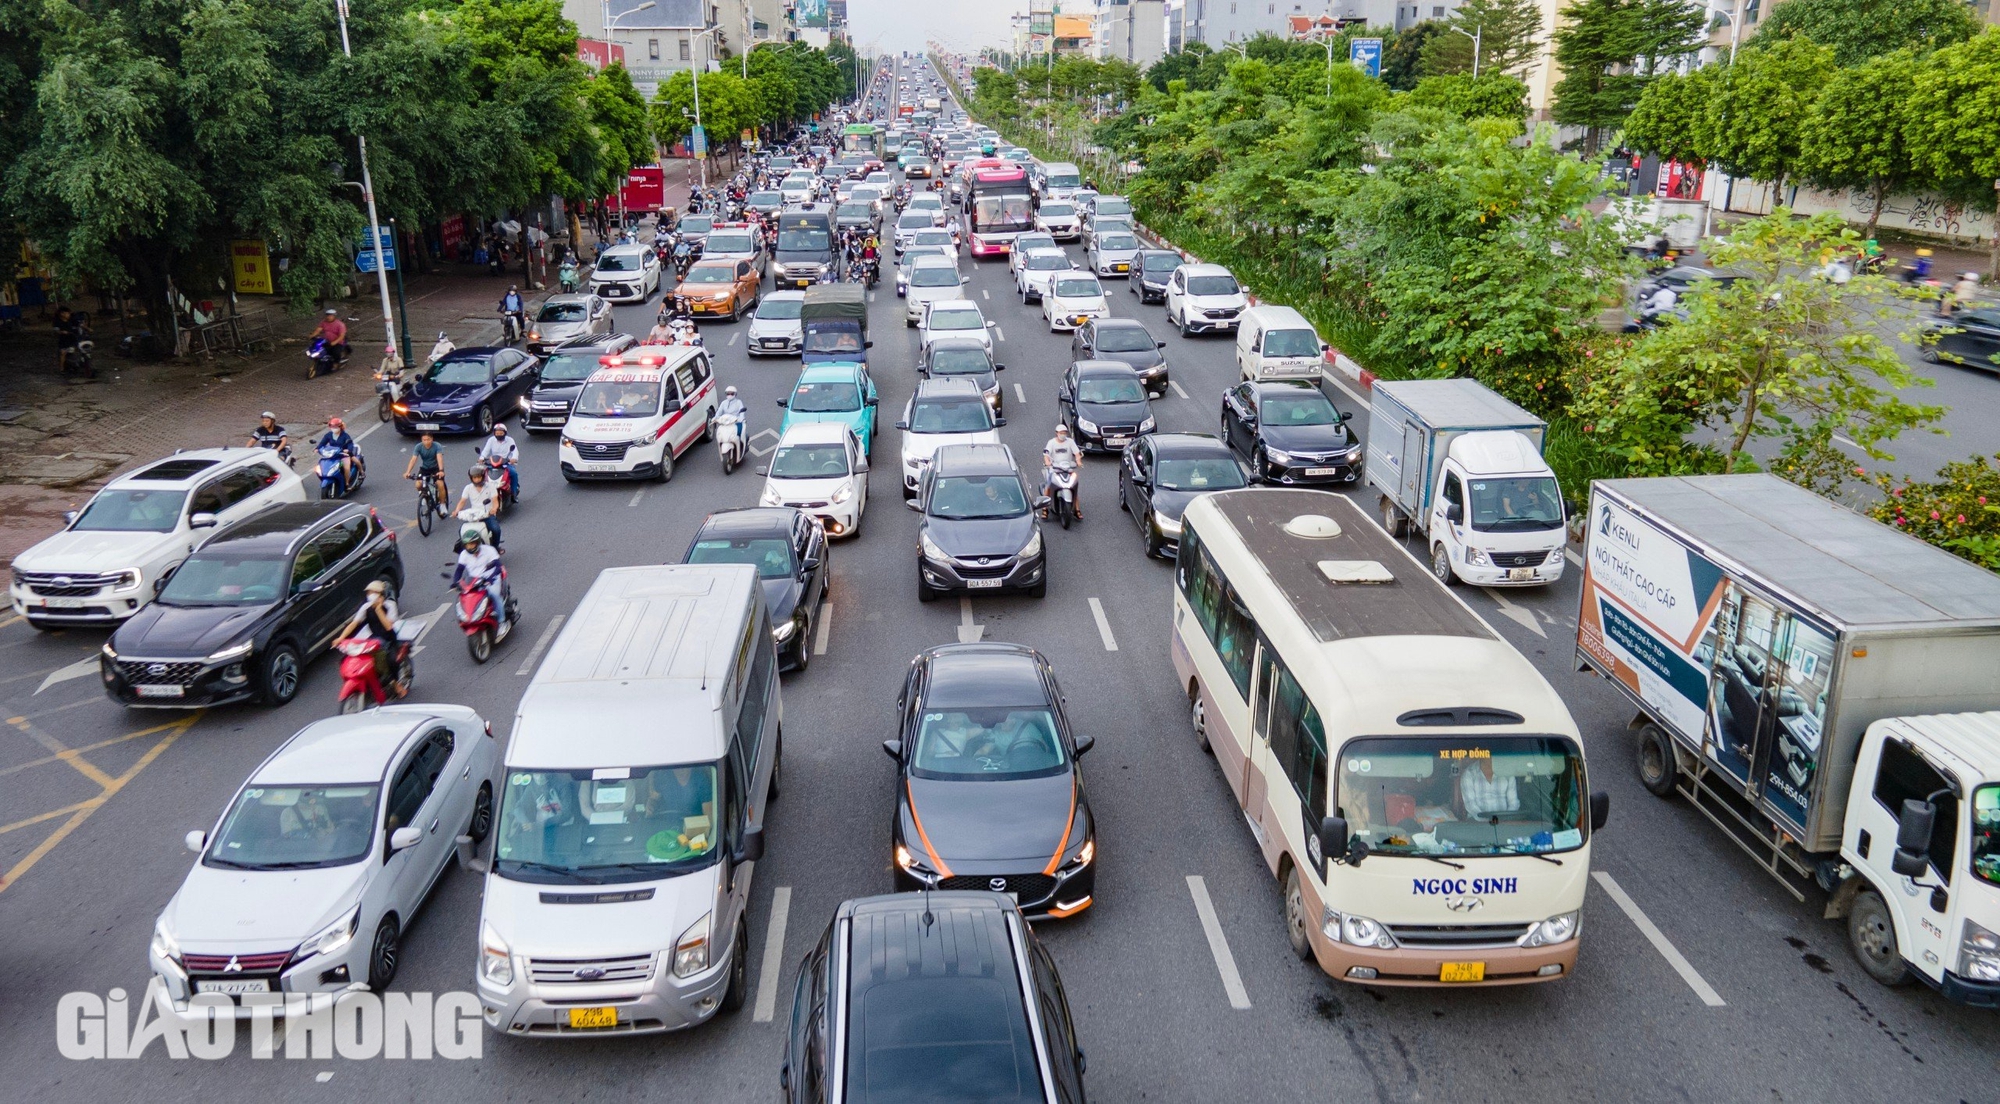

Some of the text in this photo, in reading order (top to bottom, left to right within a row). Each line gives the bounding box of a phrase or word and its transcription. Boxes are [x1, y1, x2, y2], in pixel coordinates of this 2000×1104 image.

[640, 374, 659, 383] 115
[1611, 522, 1640, 550] KENLI
[1595, 545, 1610, 566] NỘI
[1612, 555, 1634, 582] THẤT
[1635, 574, 1655, 596] CAO
[1656, 587, 1676, 609] CẤP
[1583, 617, 1602, 639] Hotline
[1581, 631, 1615, 666] 18006398
[1440, 746, 1491, 760] XE HỢP ĐỒNG
[1471, 877, 1518, 894] SINH
[1454, 963, 1473, 971] 34B
[1445, 972, 1479, 980] 027.34
[583, 1008, 603, 1016] 29B
[576, 1017, 612, 1026] 404.48
